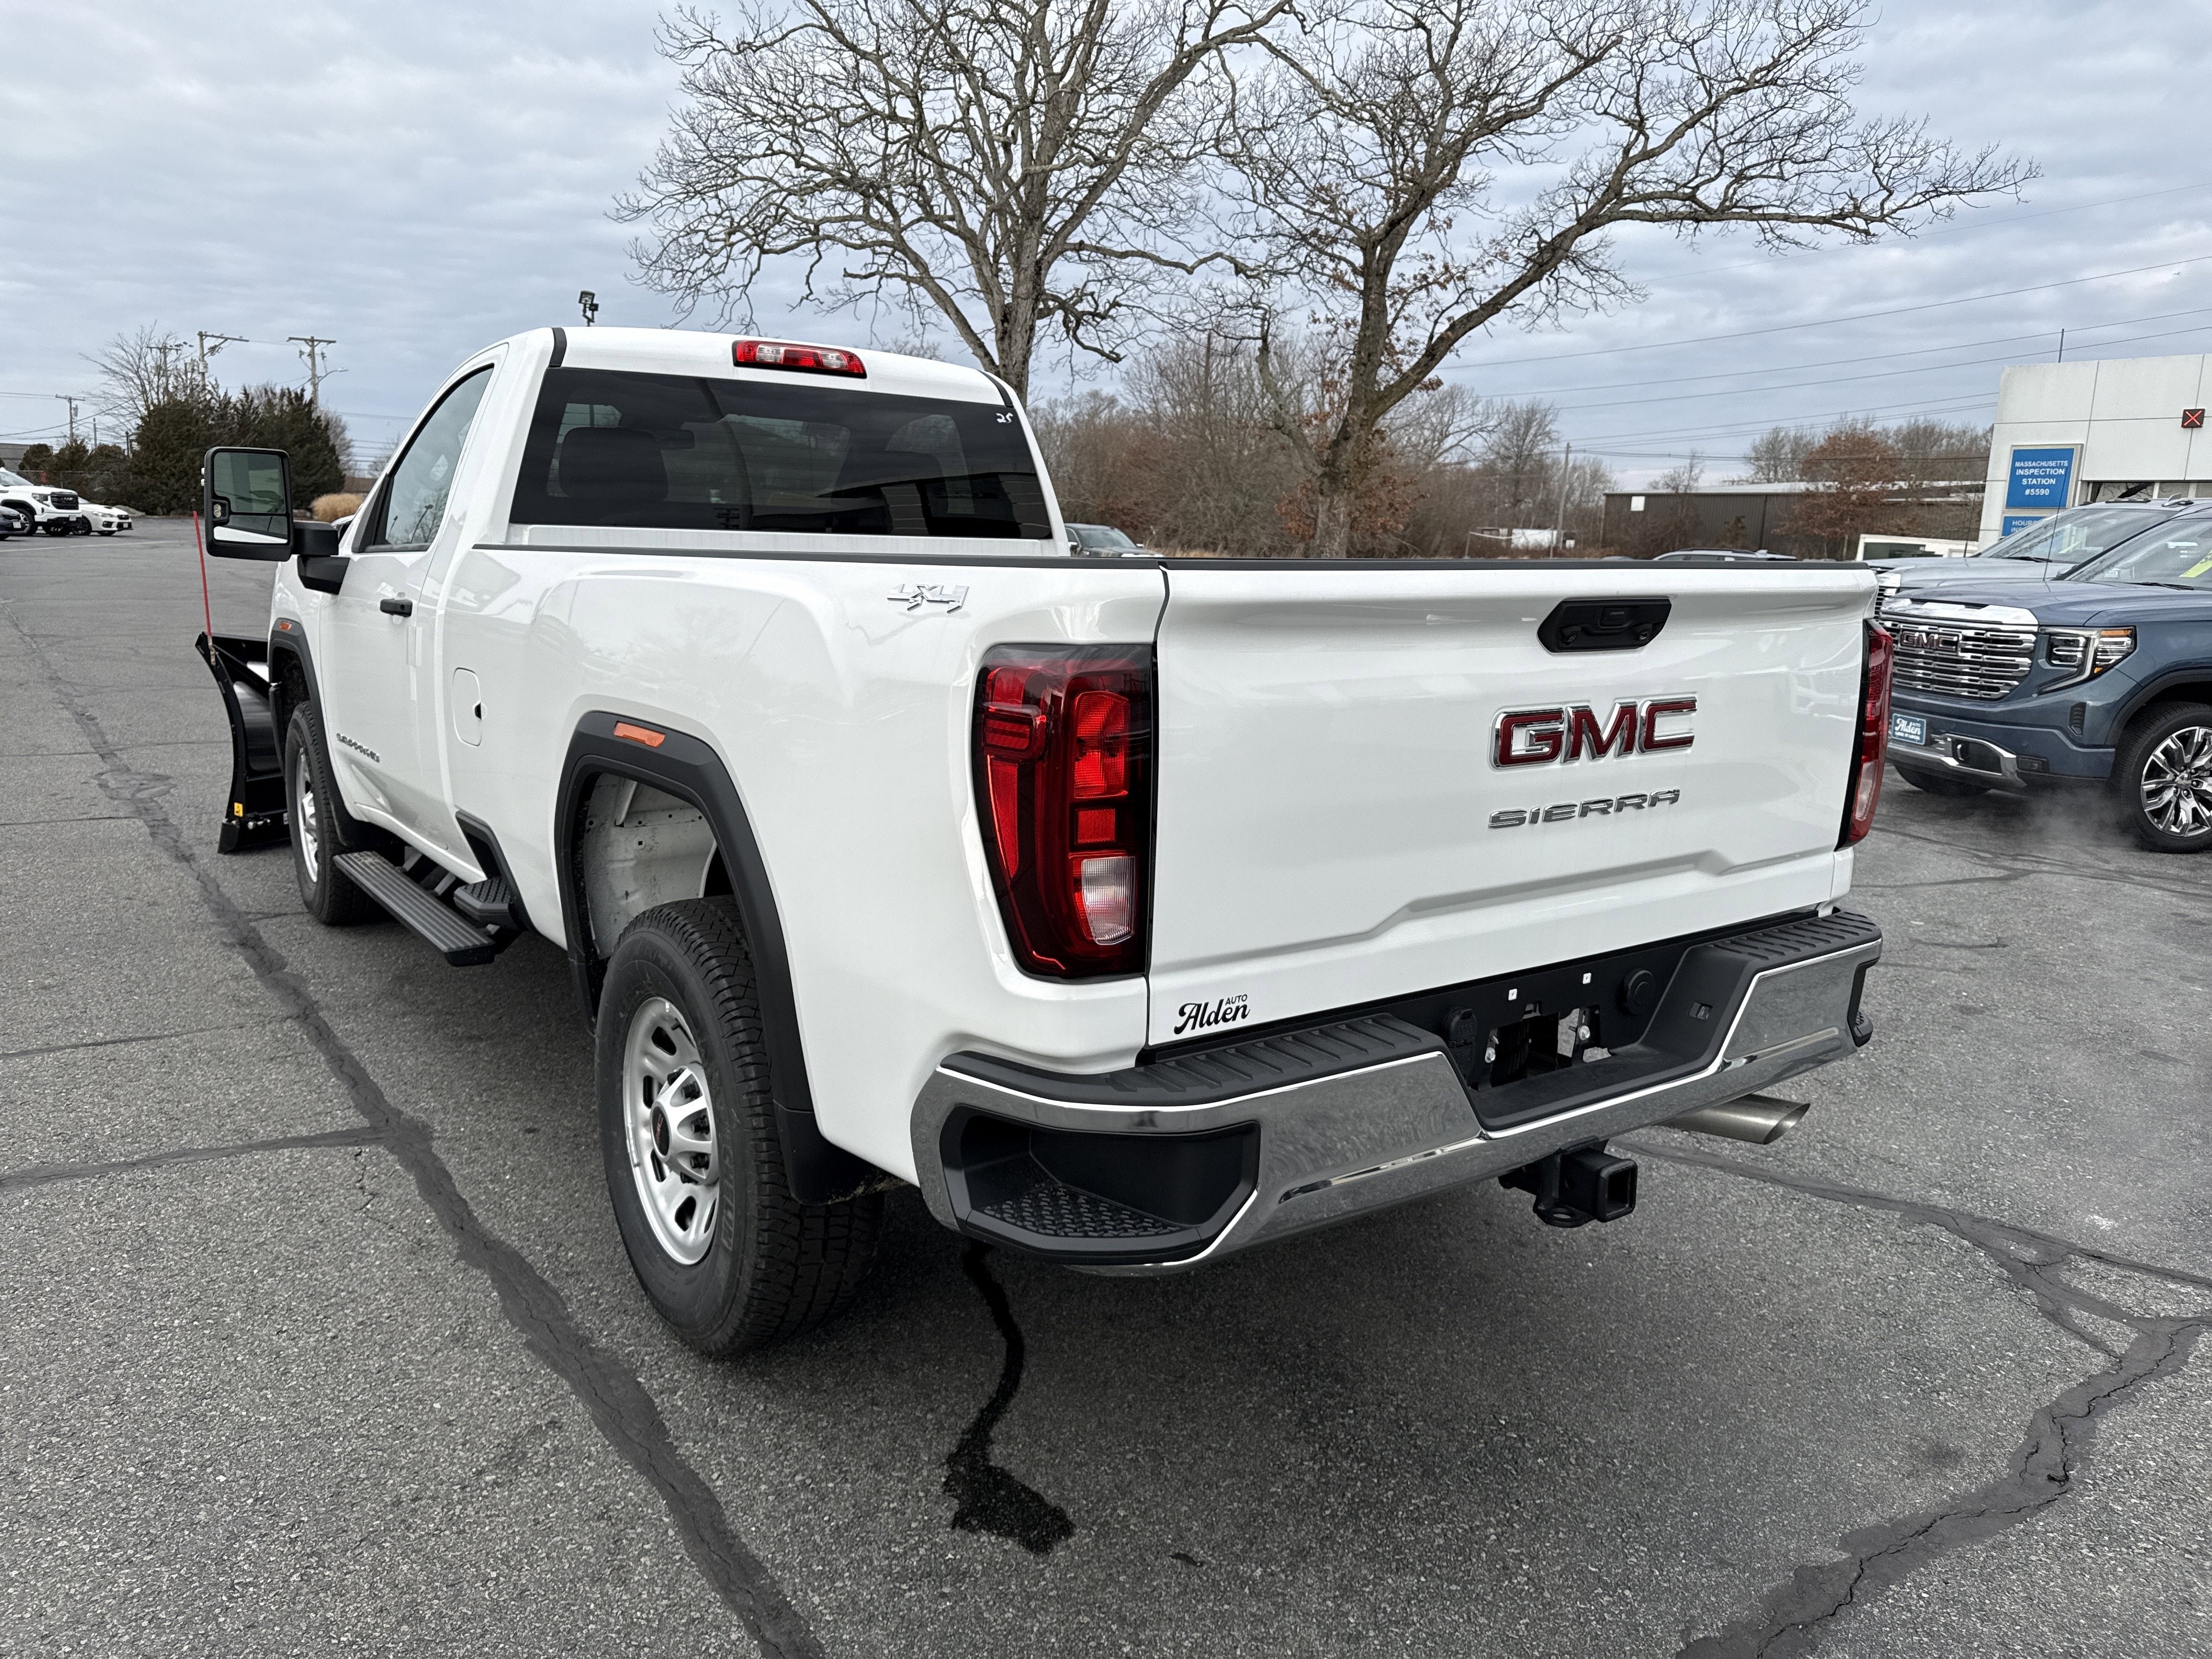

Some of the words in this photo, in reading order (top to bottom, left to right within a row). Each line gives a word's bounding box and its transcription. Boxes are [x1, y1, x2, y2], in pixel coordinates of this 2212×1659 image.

[996, 412, 1013, 423] 25
[1900, 631, 1958, 652] GMC
[1489, 696, 1697, 769] GMC
[1894, 718, 1922, 735] Alden
[1488, 788, 1680, 829] SIERRA
[1224, 994, 1248, 1006] AUTO
[1173, 998, 1251, 1035] Alden
